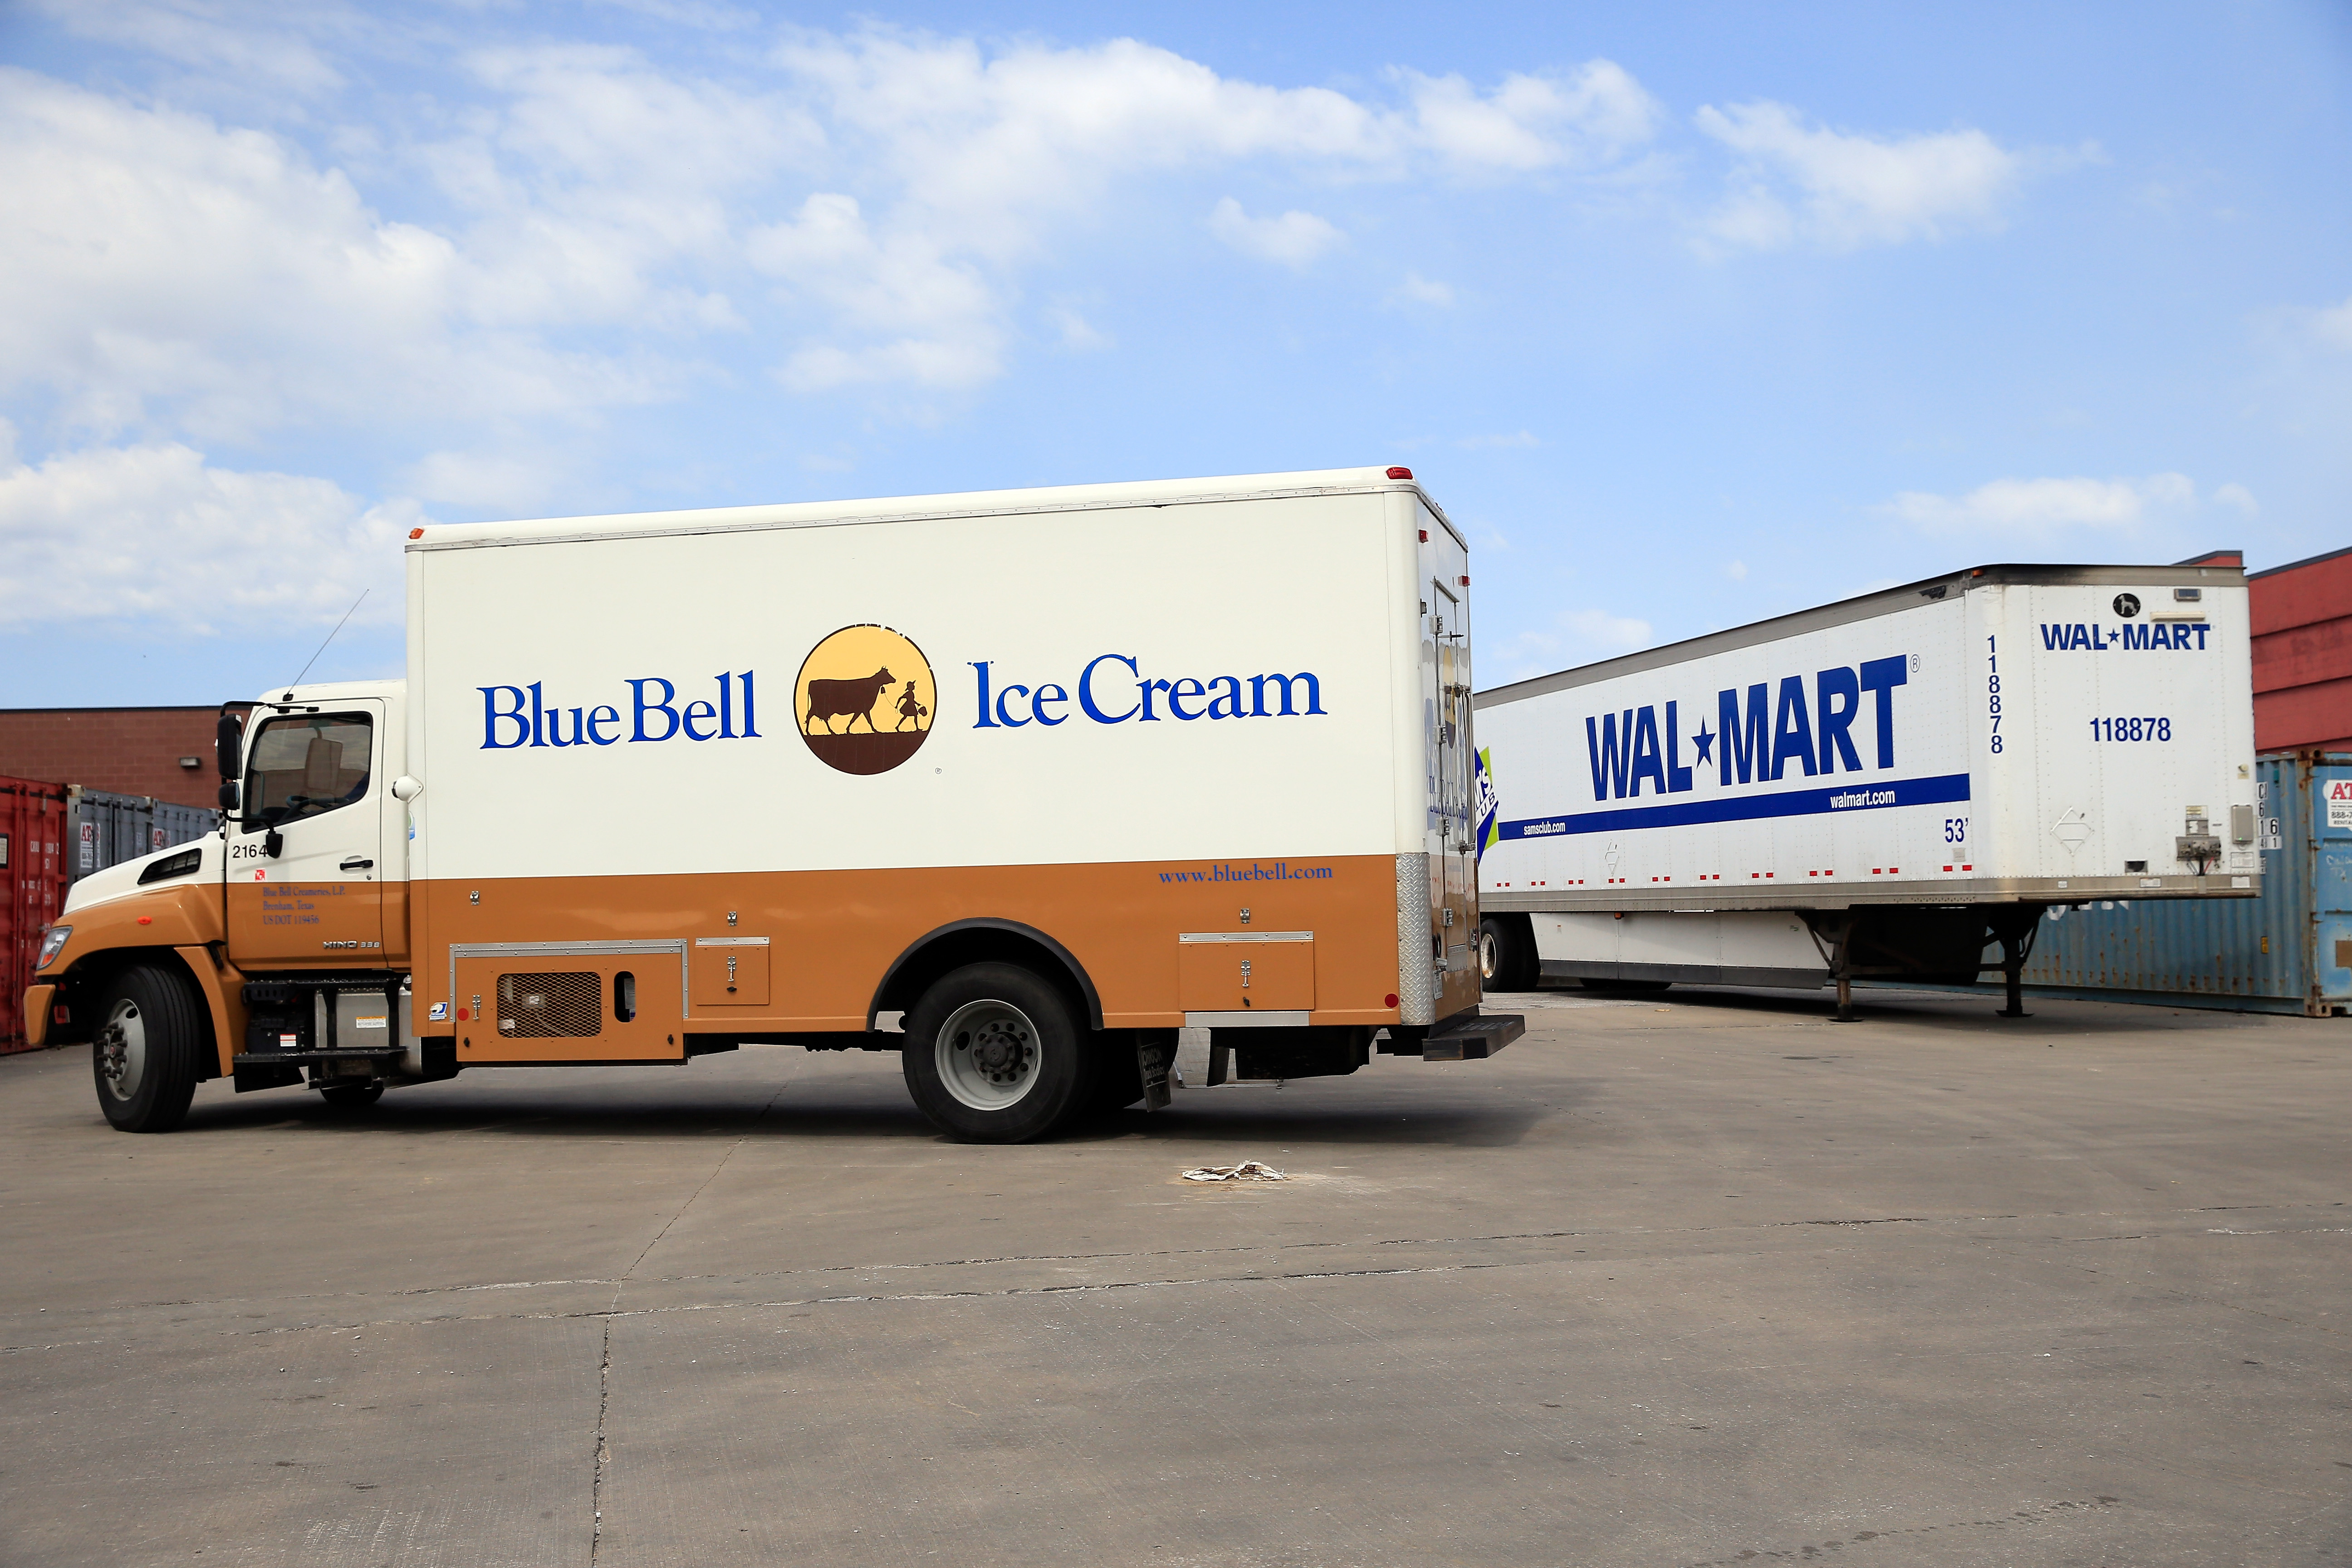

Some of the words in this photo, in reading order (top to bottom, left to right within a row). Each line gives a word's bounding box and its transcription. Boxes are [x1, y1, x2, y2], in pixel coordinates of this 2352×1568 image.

[476, 680, 621, 750] Blue
[624, 669, 763, 743] Bell
[967, 661, 1069, 729] Ice
[1078, 653, 1328, 725] Cream
[1987, 634, 2004, 754] 118878
[2090, 717, 2171, 742] 118878
[1830, 789, 1896, 808] walmart.com
[1524, 820, 1566, 836] samsclub.com
[1158, 862, 1333, 884] www.bluebell.com
[263, 887, 277, 897] Blue
[279, 887, 292, 896] Bell
[293, 886, 331, 896] Creameries,
[333, 885, 346, 896] L.P.
[263, 900, 294, 911] Brenham,
[297, 900, 314, 910] Texas
[263, 915, 273, 925] US
[275, 915, 292, 925] DOT
[323, 941, 358, 949] HINO
